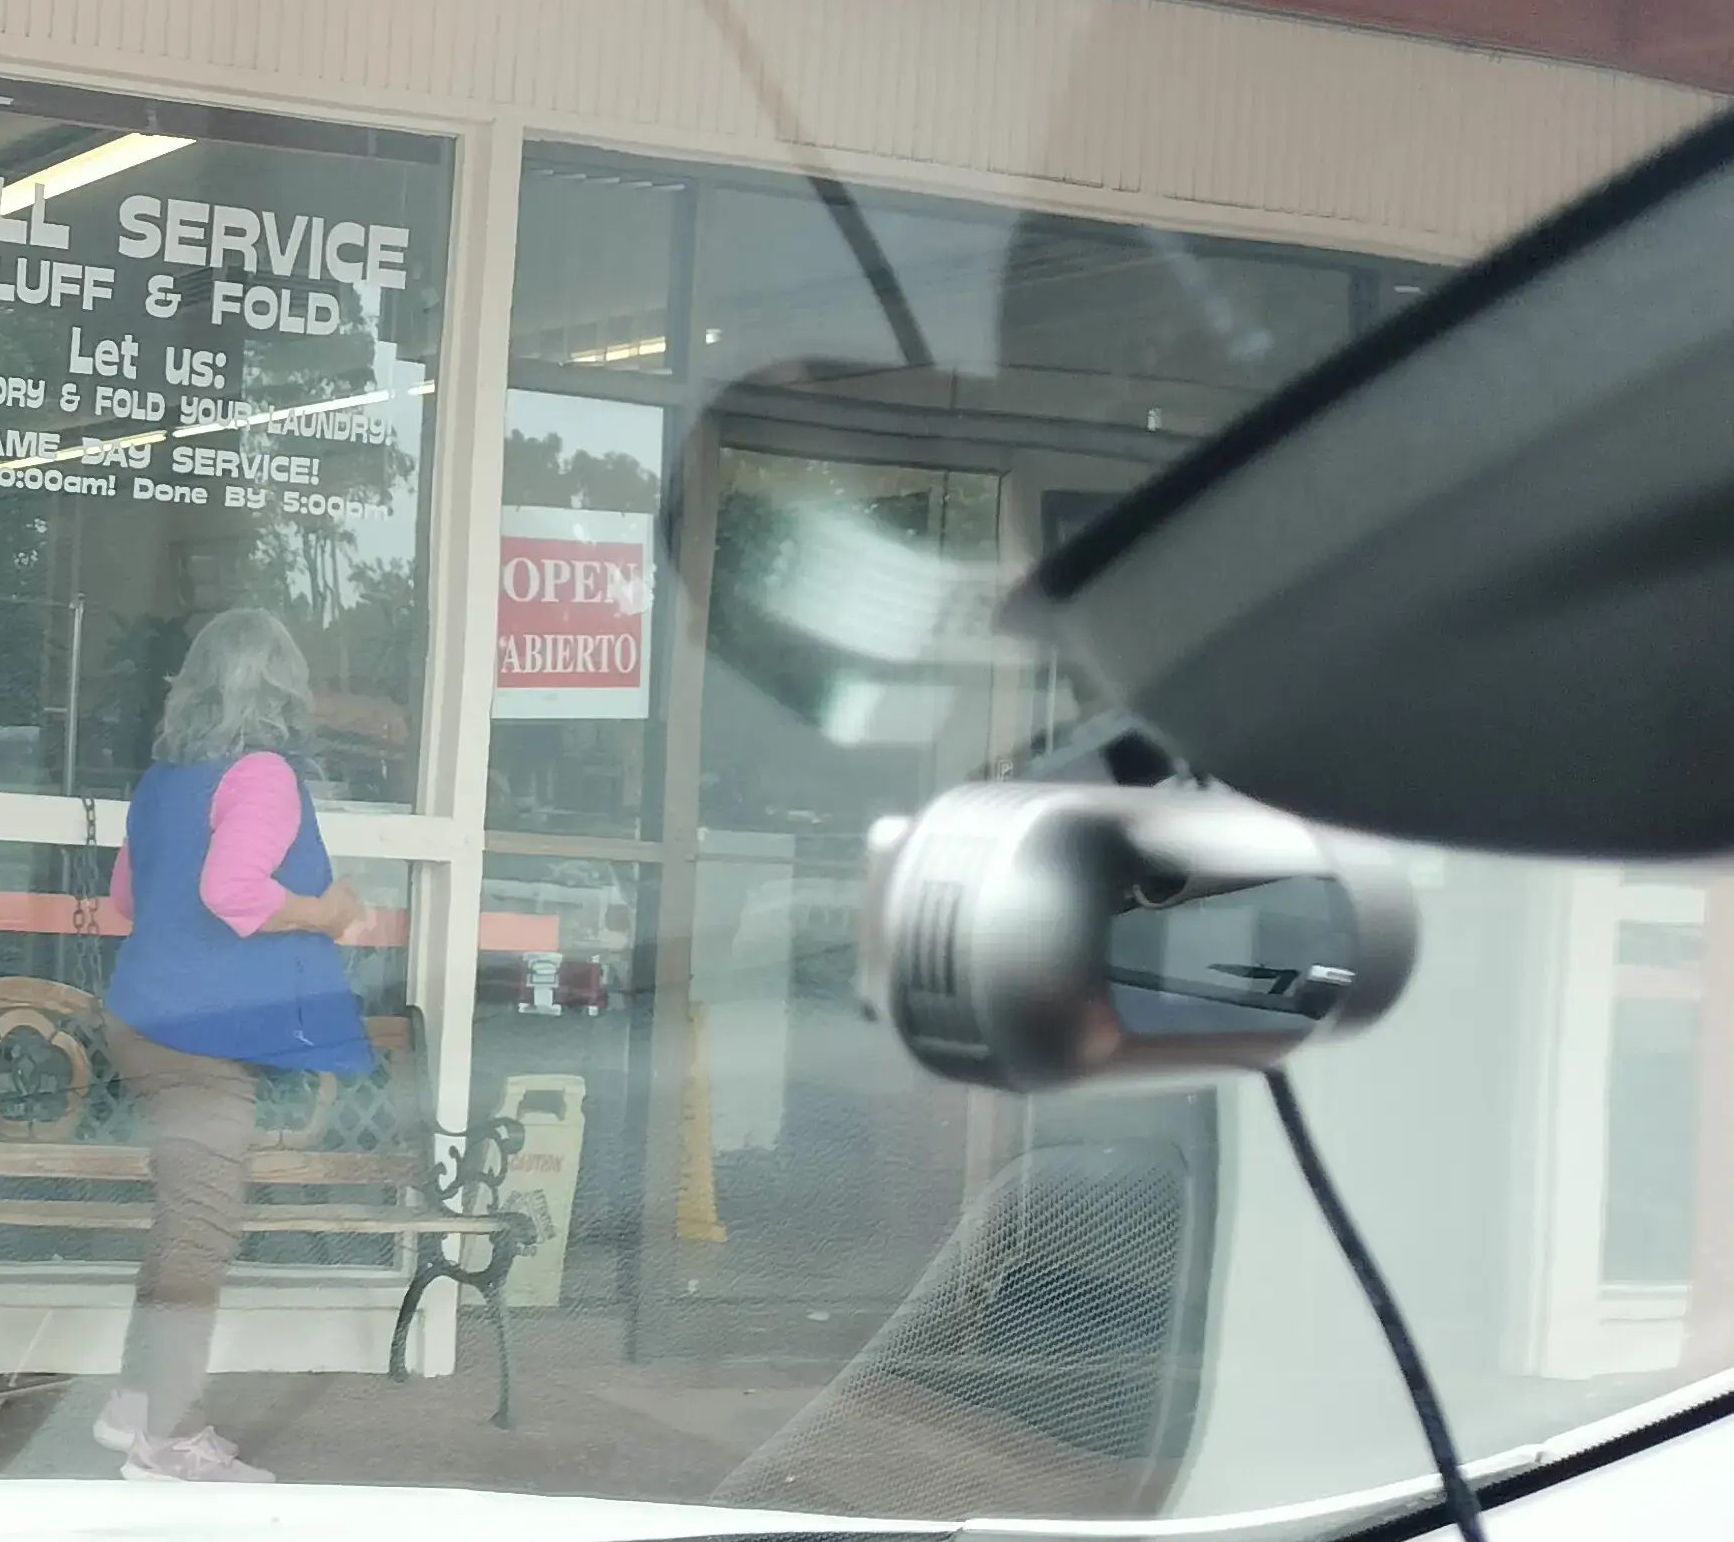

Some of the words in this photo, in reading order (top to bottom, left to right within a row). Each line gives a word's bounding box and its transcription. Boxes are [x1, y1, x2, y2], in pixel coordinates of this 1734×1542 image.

[118, 195, 410, 289] SERVICE
[145, 275, 181, 319] &
[212, 280, 340, 335] FOLD
[69, 326, 139, 379] Let
[165, 347, 226, 390] us:
[59, 383, 81, 411] &
[94, 386, 166, 421] FOLD
[180, 395, 251, 430] YOUR
[267, 405, 393, 445] LAUNDRY!
[80, 437, 152, 469] DAY
[172, 446, 320, 485] SERVICE!
[133, 477, 208, 504] Done
[224, 485, 266, 509] BY
[503, 557, 638, 604] OPEN
[500, 633, 636, 674] ABIERTO
